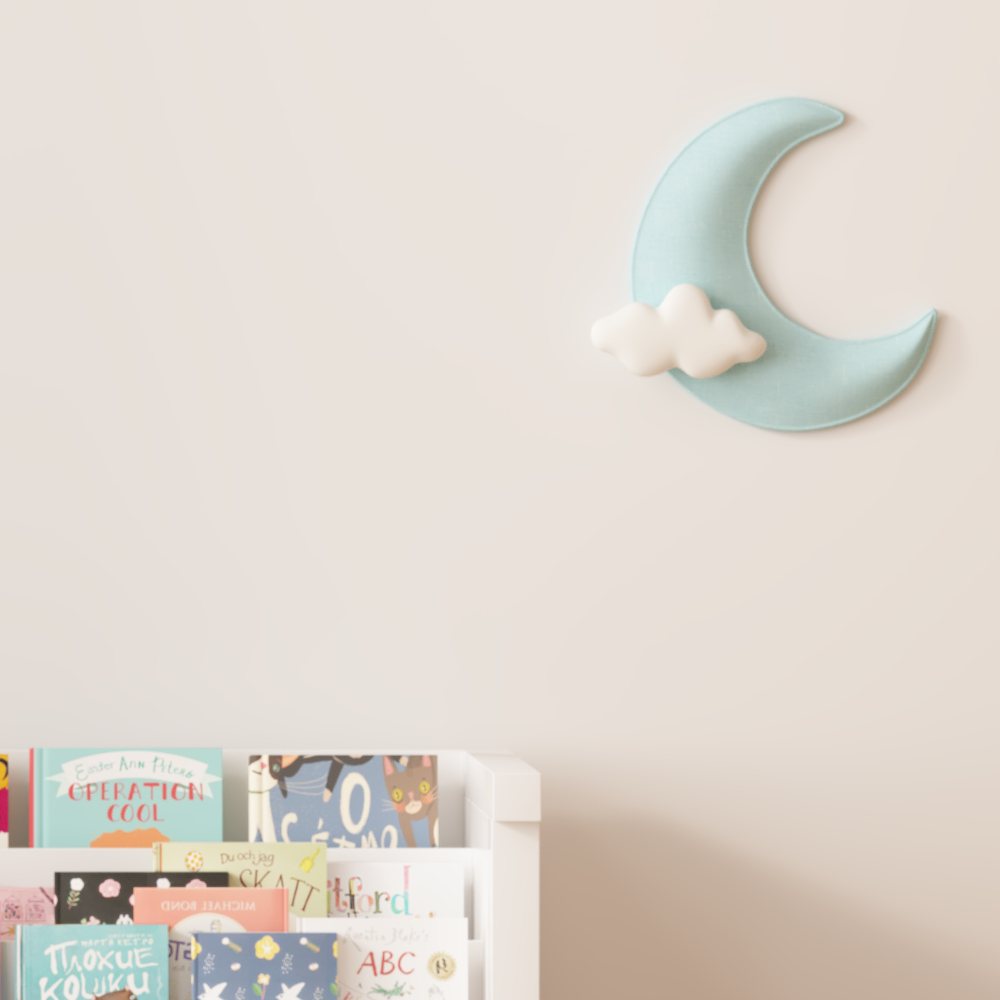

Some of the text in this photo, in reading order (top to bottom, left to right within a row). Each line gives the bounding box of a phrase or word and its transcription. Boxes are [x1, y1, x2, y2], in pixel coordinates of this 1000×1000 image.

[74, 762, 115, 781] Easter
[119, 756, 145, 772] Ann
[68, 782, 204, 801] OPERATION
[107, 803, 165, 823] COOL
[220, 850, 275, 867] Du och jag
[356, 950, 416, 977] ABC
